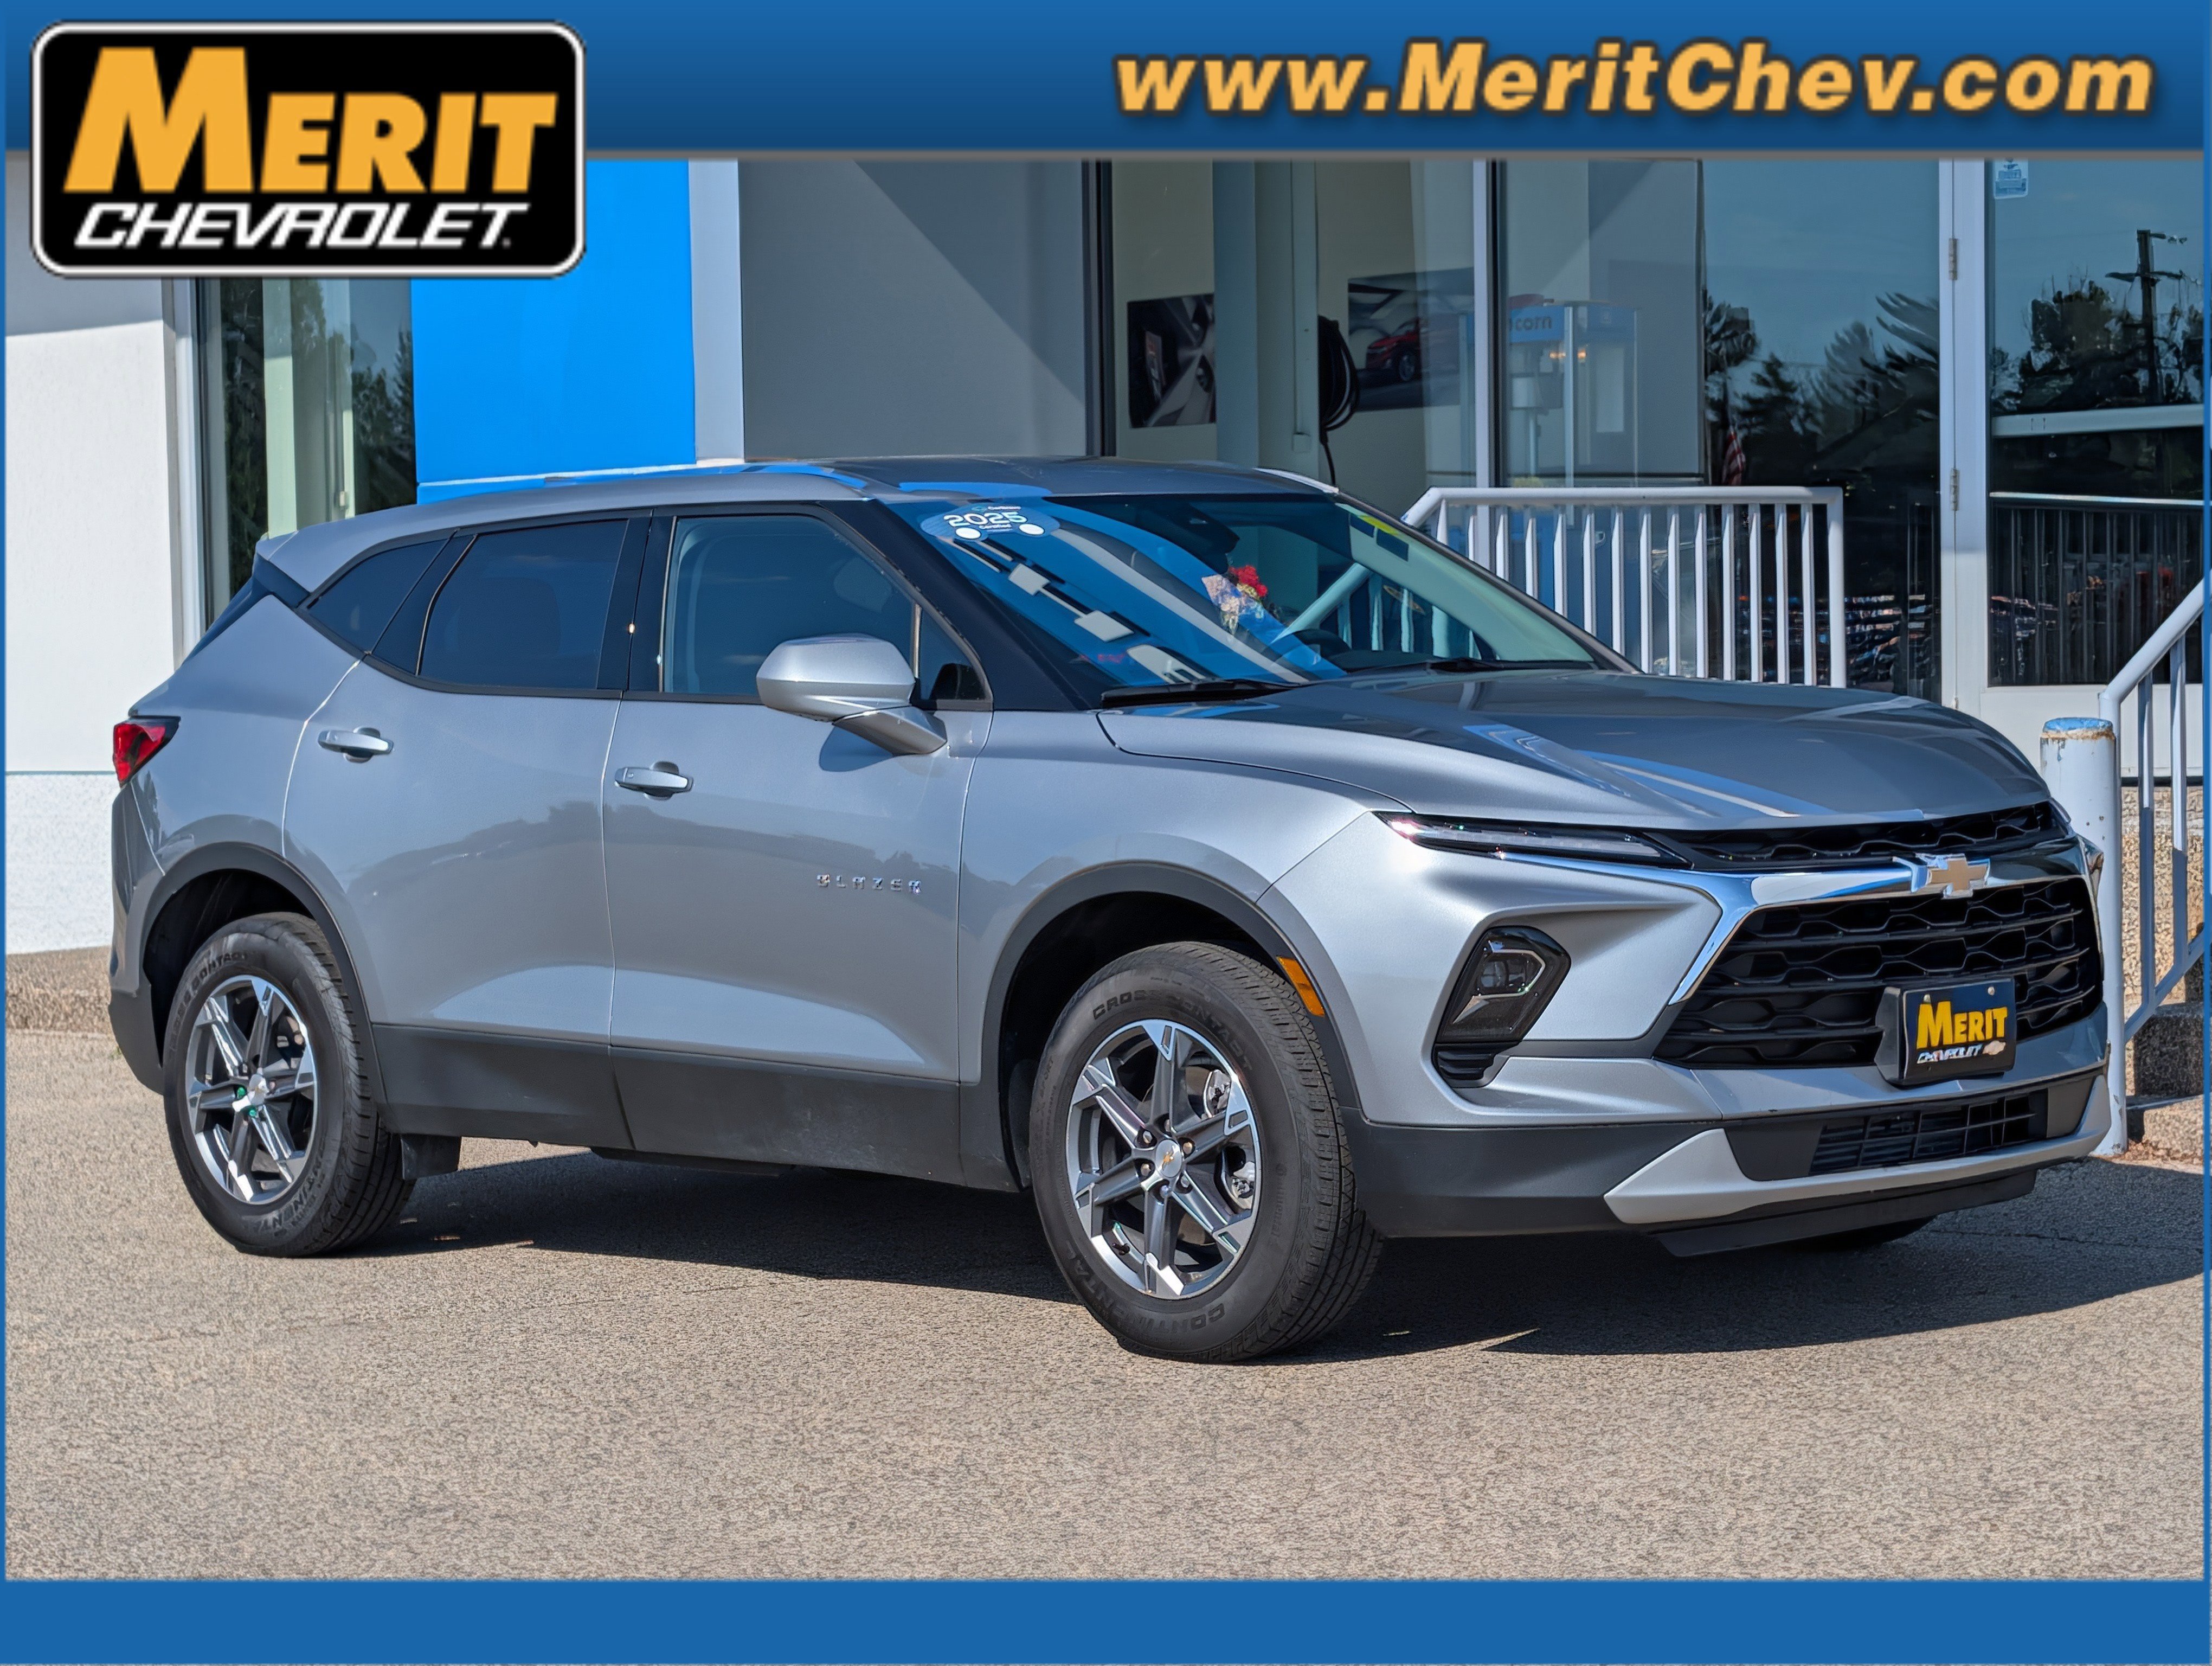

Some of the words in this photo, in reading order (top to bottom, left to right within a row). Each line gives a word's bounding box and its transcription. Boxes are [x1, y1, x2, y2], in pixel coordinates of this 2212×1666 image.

[943, 511, 1027, 527] 2025
[816, 874, 921, 895] BLAZER
[1917, 1001, 2008, 1049] MERIT
